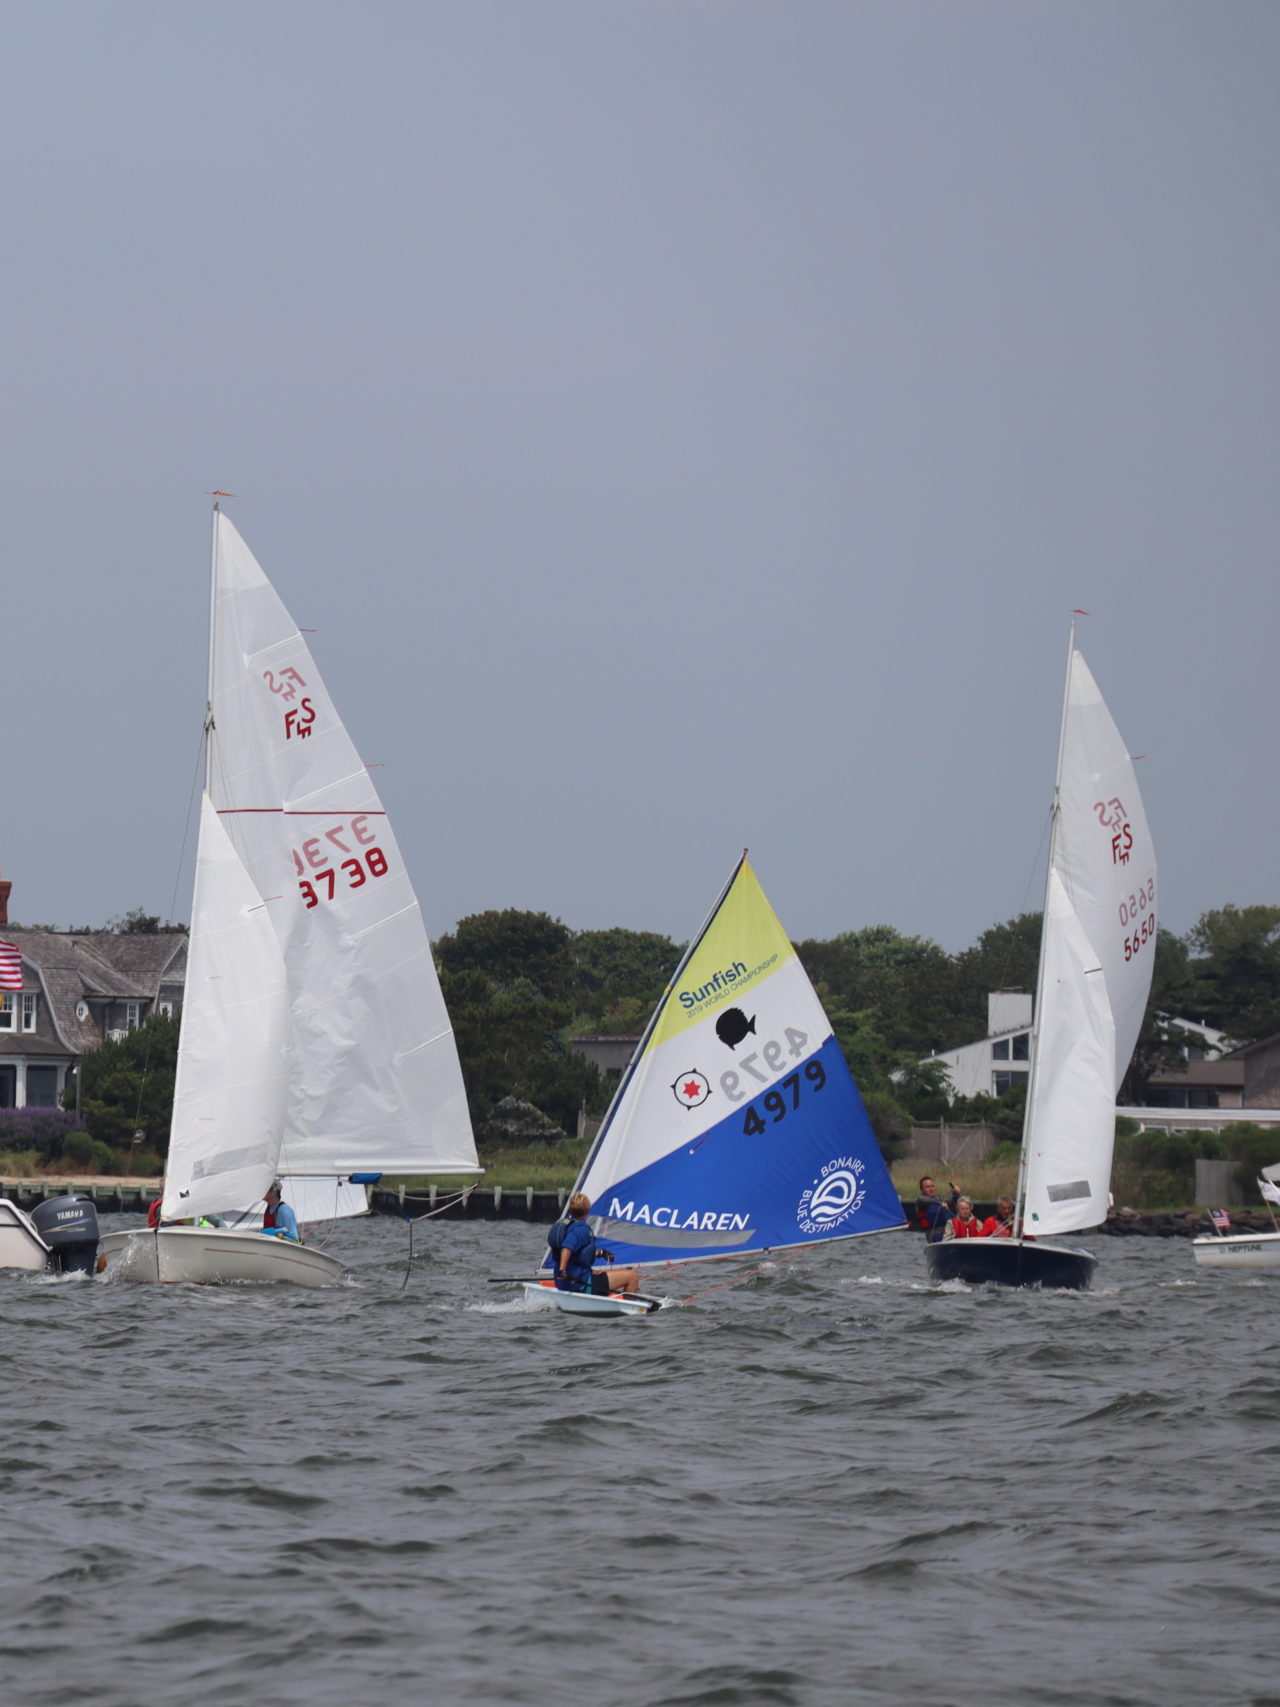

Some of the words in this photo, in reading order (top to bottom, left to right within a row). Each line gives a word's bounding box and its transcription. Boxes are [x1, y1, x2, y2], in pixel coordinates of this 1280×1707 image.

[299, 846, 389, 910] 3738
[1124, 912, 1155, 962] 5650
[679, 961, 748, 1009] Sunfish
[686, 1005, 704, 1019] 2019
[703, 987, 730, 1008] WORLD
[730, 953, 779, 991] CHAMPIONSHIP
[743, 1060, 826, 1136] 4979
[820, 1156, 865, 1178] BONAIRE
[608, 1197, 751, 1231] MACLAREN
[797, 1190, 813, 1222] BLUE
[799, 1190, 867, 1234] DESTINATION
